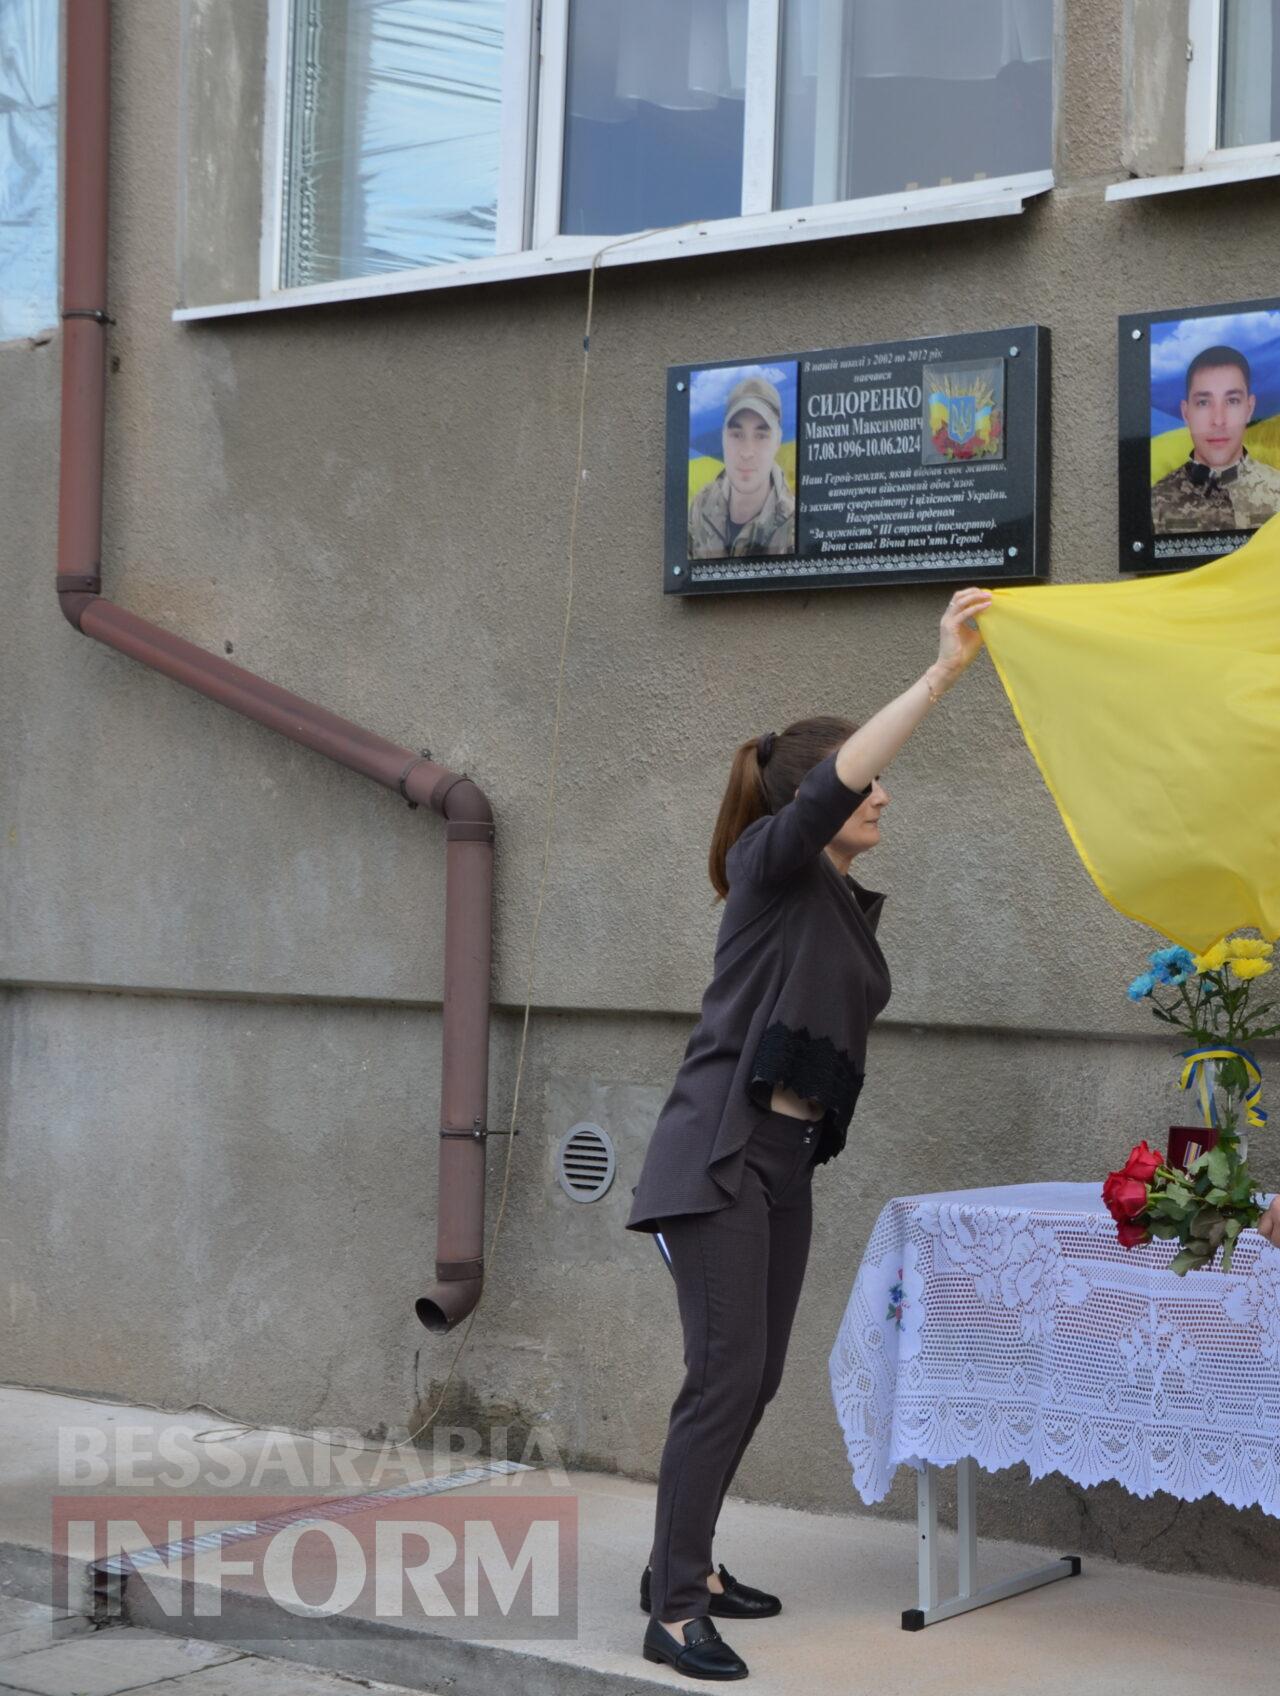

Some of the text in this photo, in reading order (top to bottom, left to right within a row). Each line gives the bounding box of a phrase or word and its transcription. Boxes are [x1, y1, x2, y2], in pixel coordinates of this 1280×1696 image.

[803, 361, 811, 373] В
[812, 359, 838, 372] нашій
[840, 356, 866, 369] школі
[873, 353, 894, 366] 2002
[895, 353, 906, 364] по
[907, 350, 928, 363] 2012
[928, 348, 944, 362] рік
[853, 371, 893, 383] навчався
[807, 384, 923, 420] СИДОРЕНКО
[804, 417, 924, 440] Максим Максимович
[808, 435, 922, 461] 17.08.1996-10.06.2024
[801, 474, 823, 486] Наш
[824, 471, 888, 486] Герой-земляк,
[888, 467, 912, 480] який
[913, 466, 943, 478] віддав
[965, 462, 1008, 474] життя,
[800, 502, 808, 513] із
[809, 501, 846, 513] захисту
[846, 496, 909, 512] суверенітету
[915, 491, 966, 506] цілісності
[966, 488, 1008, 504] України.
[828, 486, 878, 498] виконуючи
[878, 481, 929, 495] військовий
[845, 507, 956, 525] Нагороджений орденом
[893, 523, 933, 536] ступеня
[934, 517, 998, 533] (посмертно).
[821, 541, 848, 553] Вічна
[848, 537, 878, 551] слава!
[879, 536, 907, 549] Вічна
[949, 531, 985, 547] Герою!
